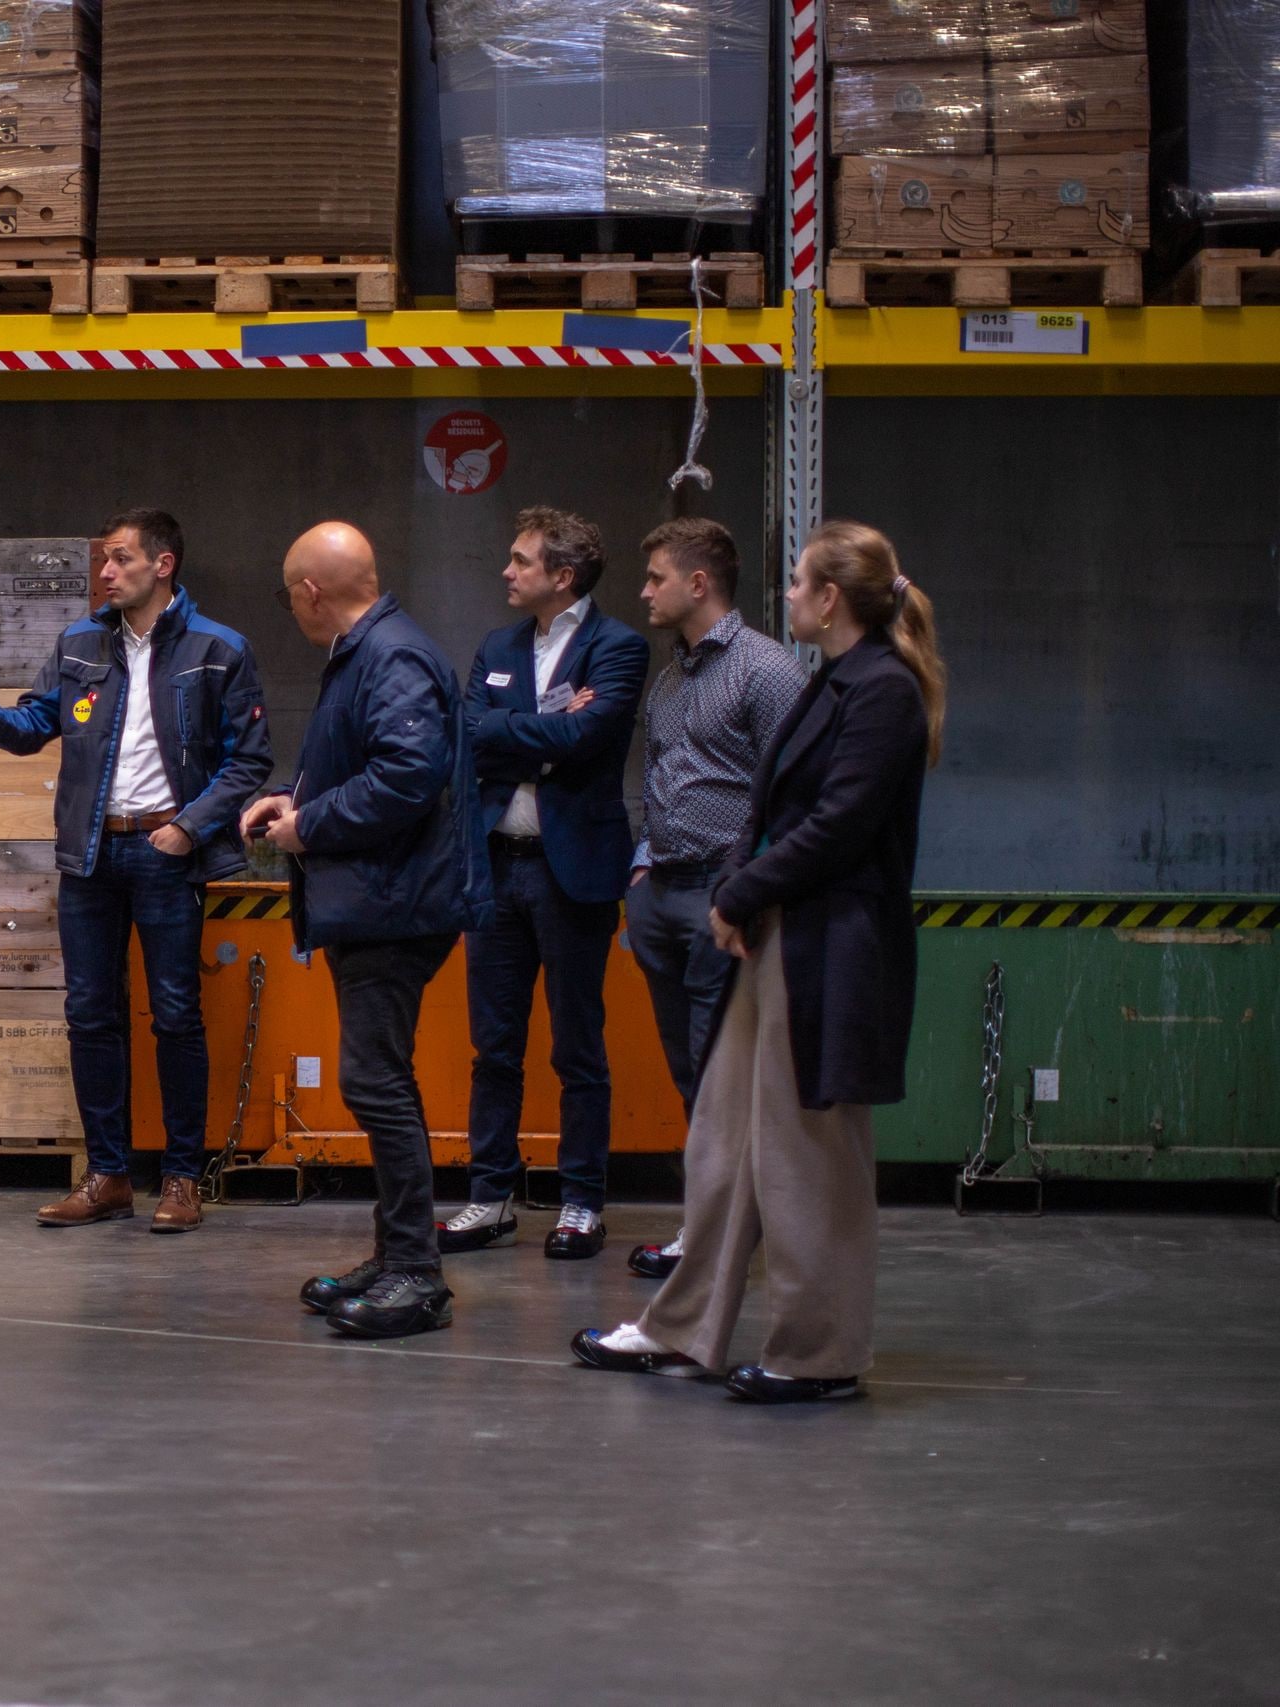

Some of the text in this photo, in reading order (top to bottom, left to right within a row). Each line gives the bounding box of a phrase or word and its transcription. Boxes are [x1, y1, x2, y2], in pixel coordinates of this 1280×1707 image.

[981, 314, 1008, 325] 013
[1040, 315, 1074, 327] 9625
[450, 418, 481, 427] DÉCHETS
[447, 427, 485, 436] RÉSIDUELS
[6, 1027, 27, 1038] SBB
[29, 1027, 49, 1038] CFF
